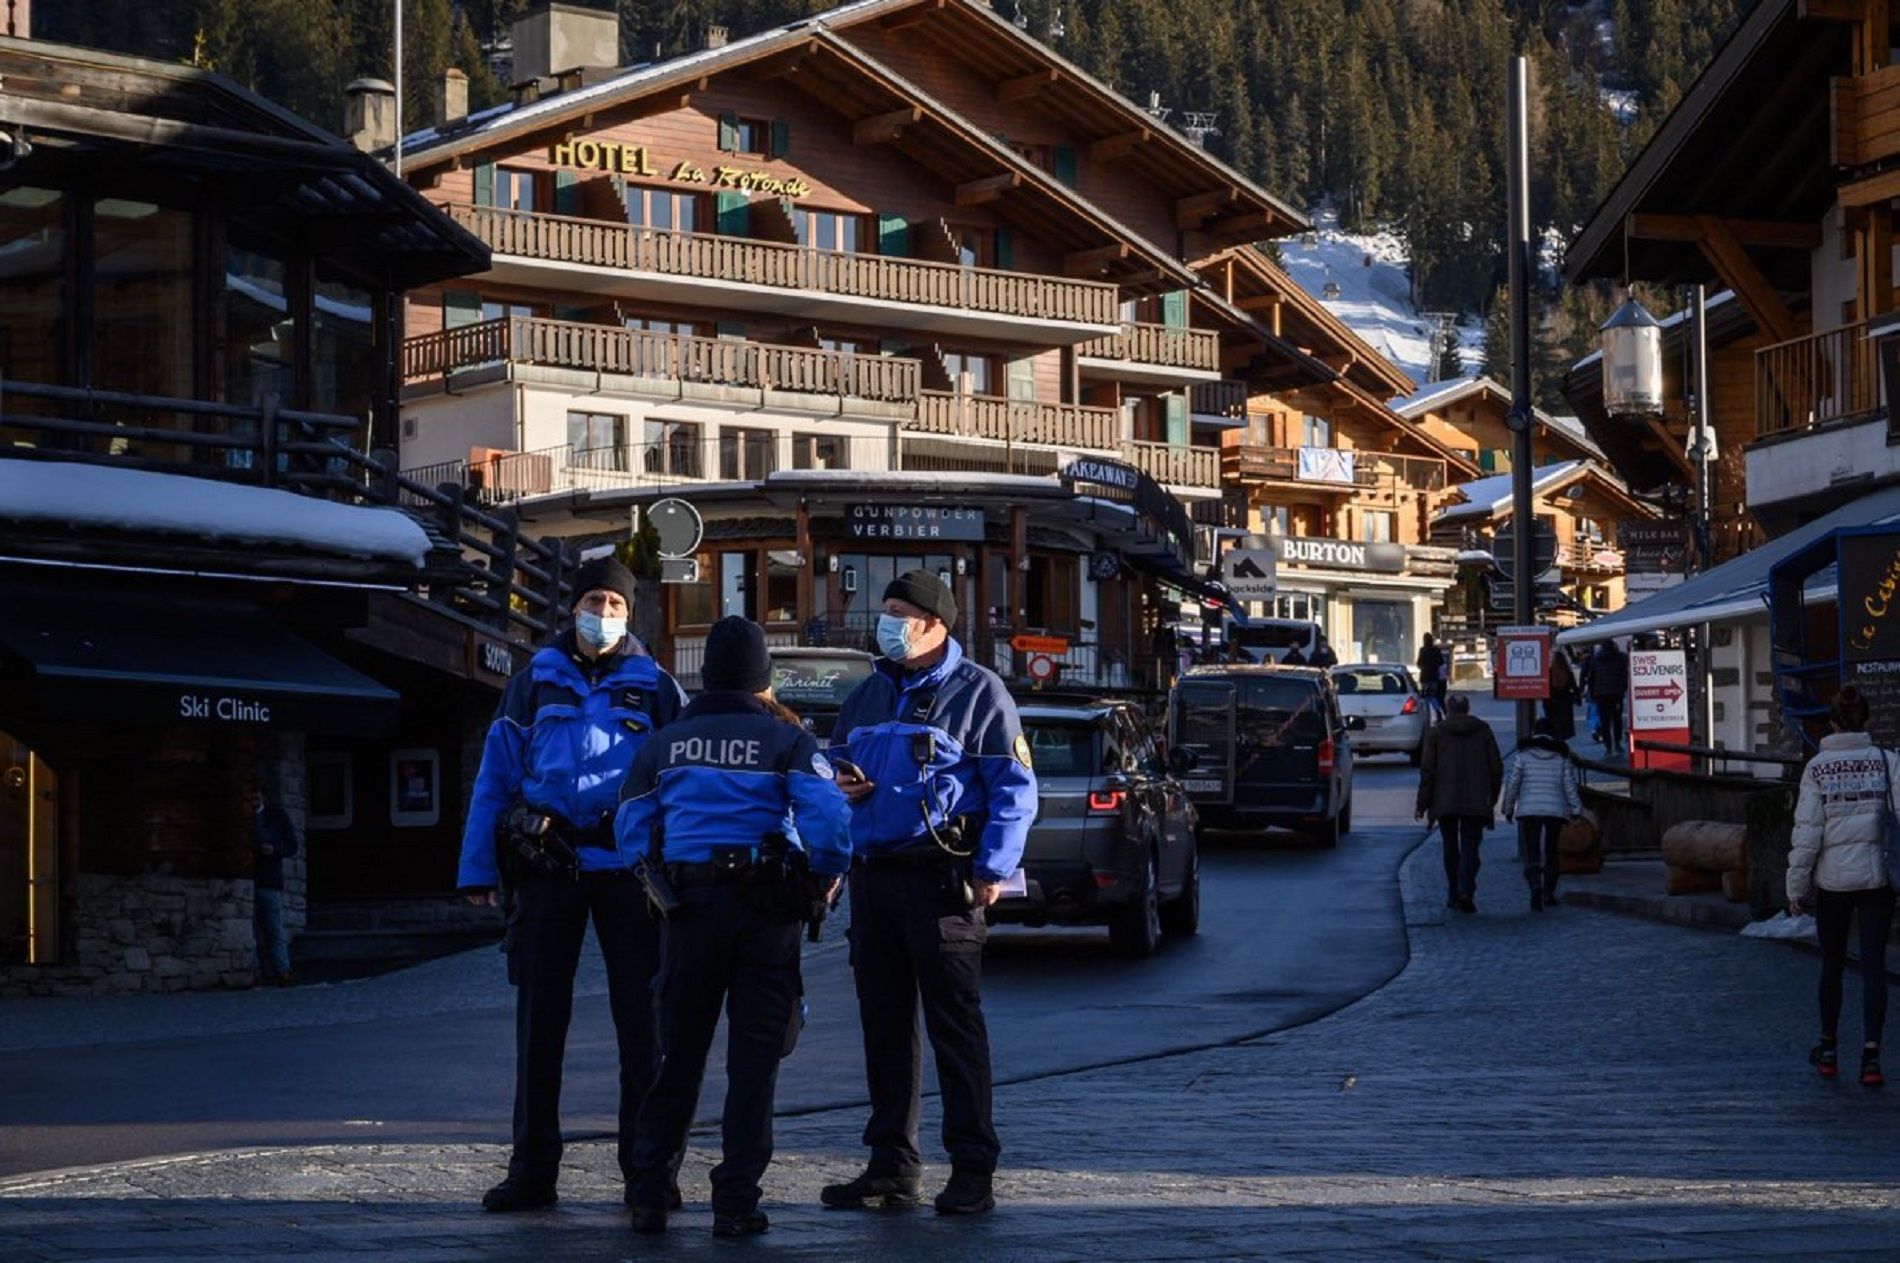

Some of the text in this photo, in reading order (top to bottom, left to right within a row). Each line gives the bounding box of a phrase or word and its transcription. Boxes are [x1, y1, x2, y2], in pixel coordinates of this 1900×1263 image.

[555, 138, 658, 176] HOTEL
[673, 161, 706, 183] La
[853, 505, 976, 520] GUNPOWDER
[853, 525, 940, 537] VERBIER
[1283, 539, 1365, 565] BURTON
[1226, 583, 1274, 594] backside
[1632, 665, 1684, 677] SOUVENIRS
[180, 695, 271, 722] Ski Clinic
[670, 737, 761, 765] POLICE
